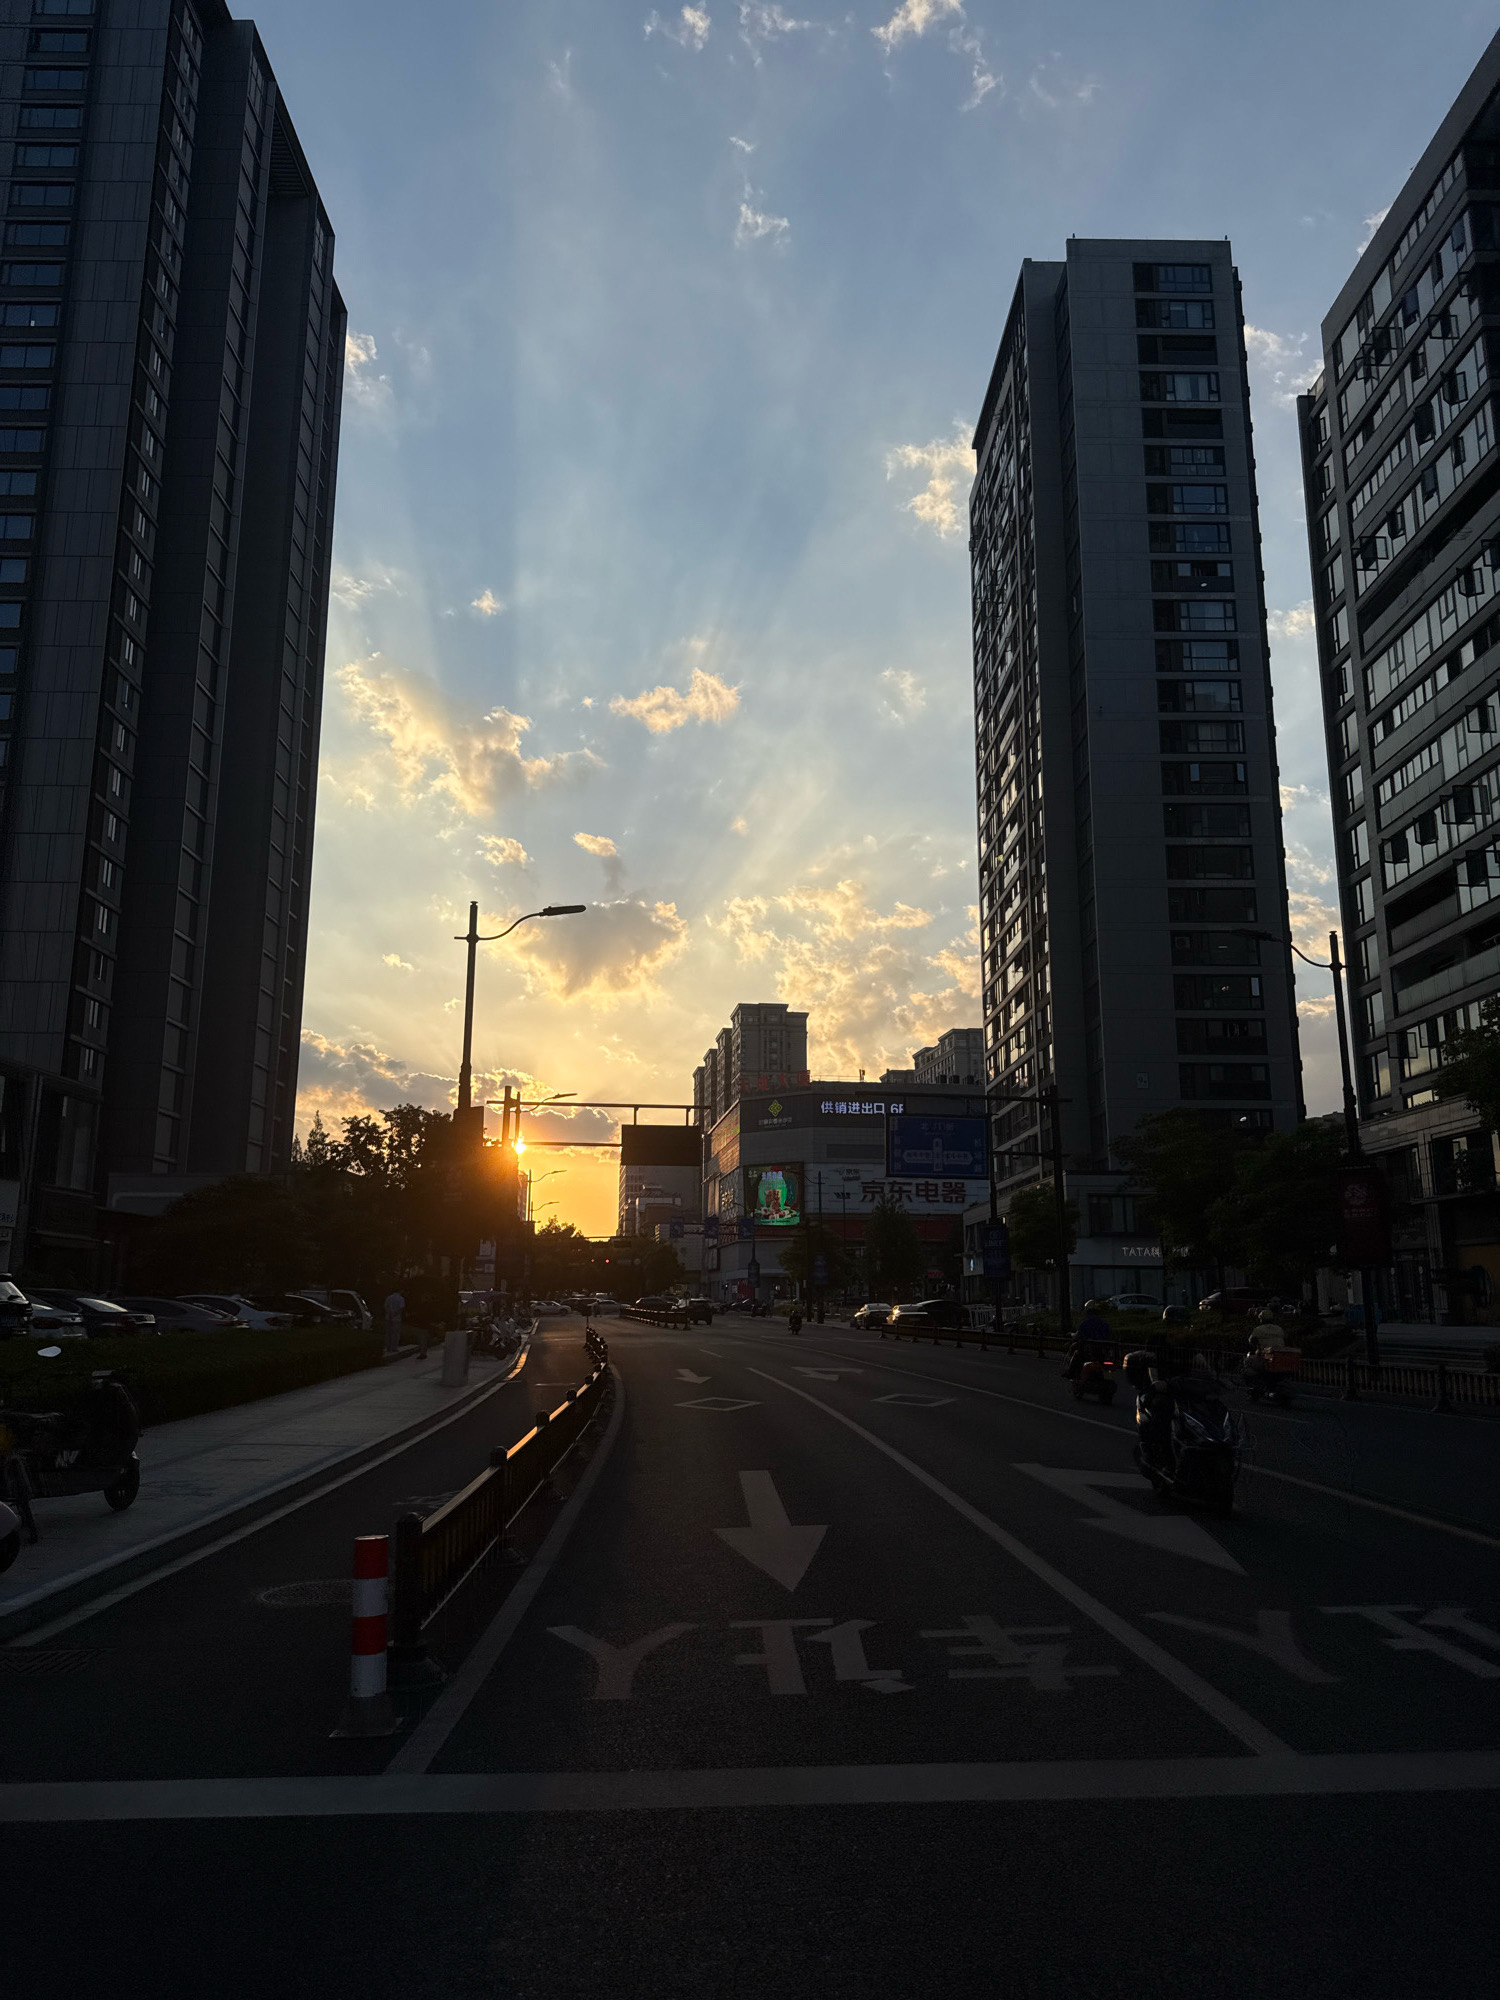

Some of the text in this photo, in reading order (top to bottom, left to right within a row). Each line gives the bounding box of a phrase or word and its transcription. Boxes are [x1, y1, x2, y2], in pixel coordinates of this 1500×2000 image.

[820, 1101, 886, 1114] 供销进出口
[861, 1180, 966, 1203] 京东电器
